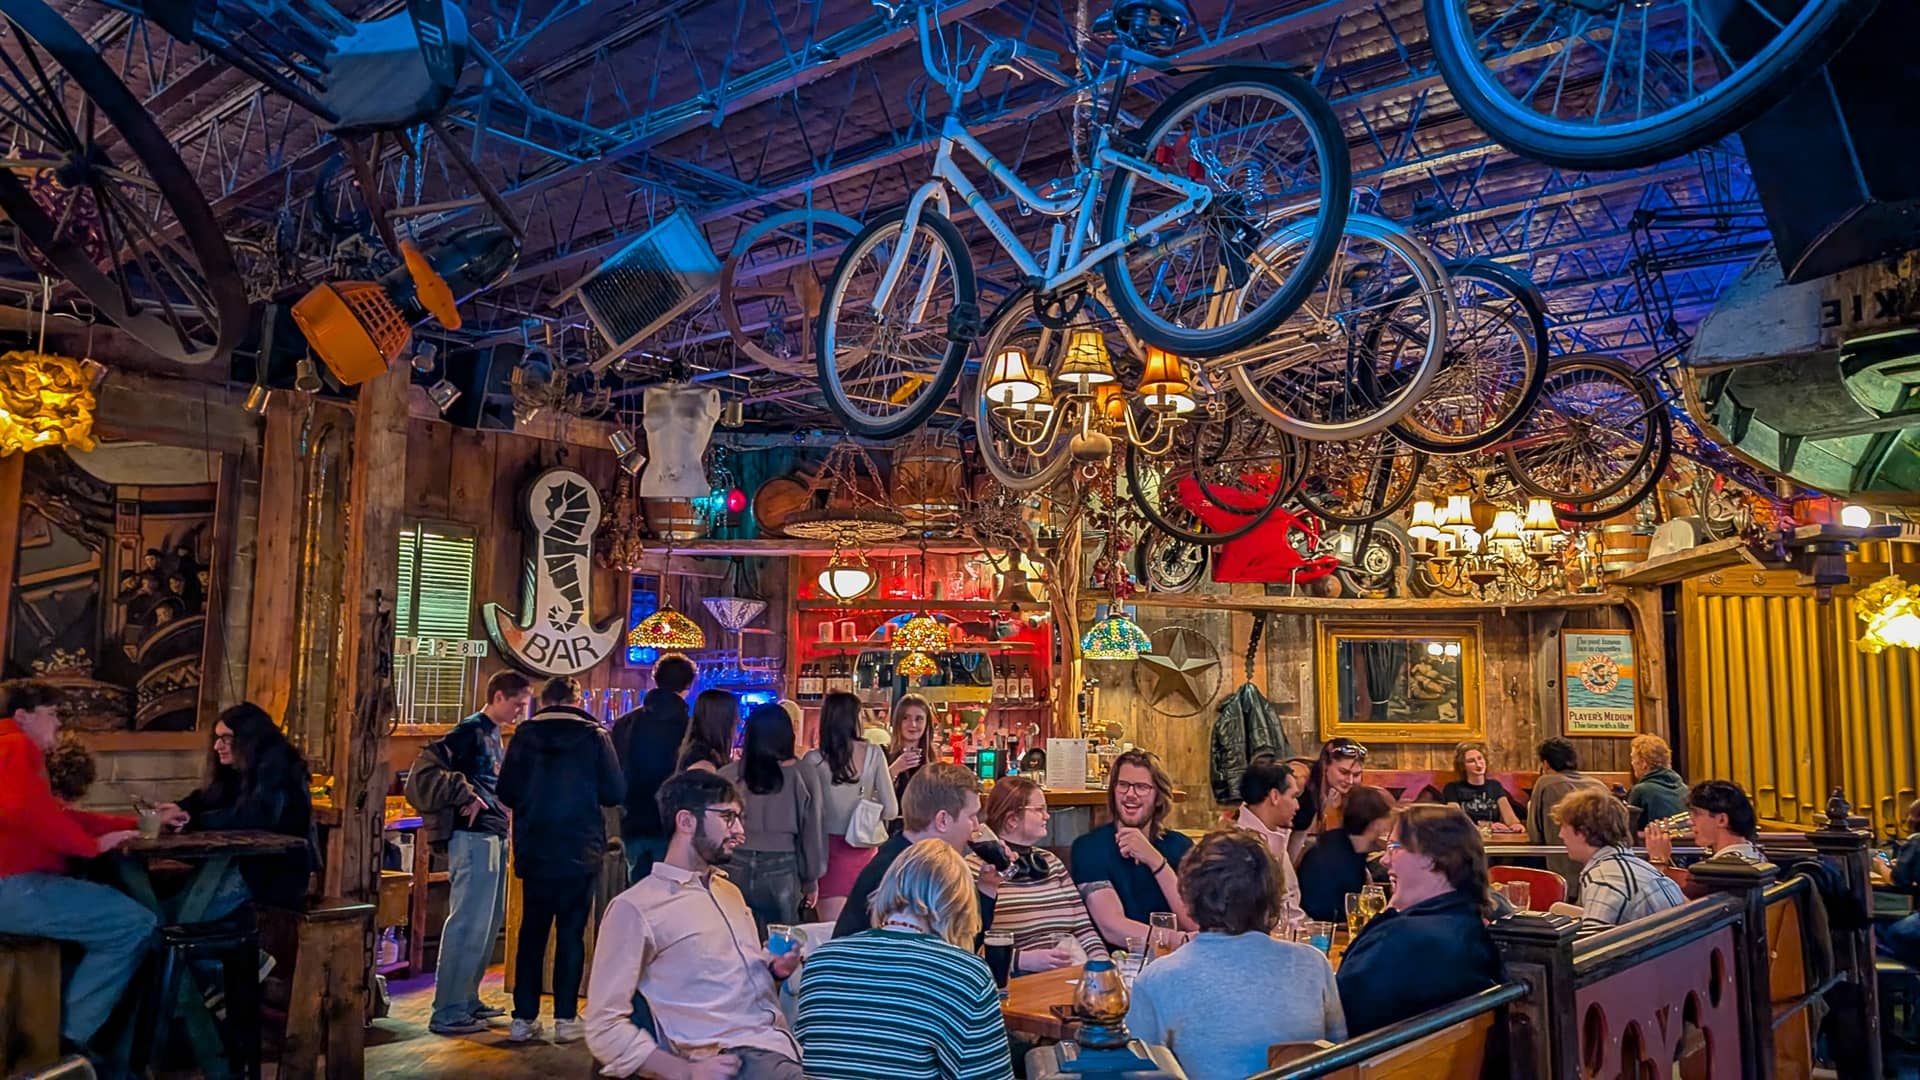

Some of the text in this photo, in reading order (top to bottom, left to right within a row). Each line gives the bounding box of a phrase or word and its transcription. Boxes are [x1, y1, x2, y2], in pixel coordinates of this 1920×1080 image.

[462, 642, 469, 654] 8
[474, 643, 485, 653] 10
[521, 633, 600, 669] BAR
[1569, 711, 1633, 721] PLAYER'S MEDIUM
